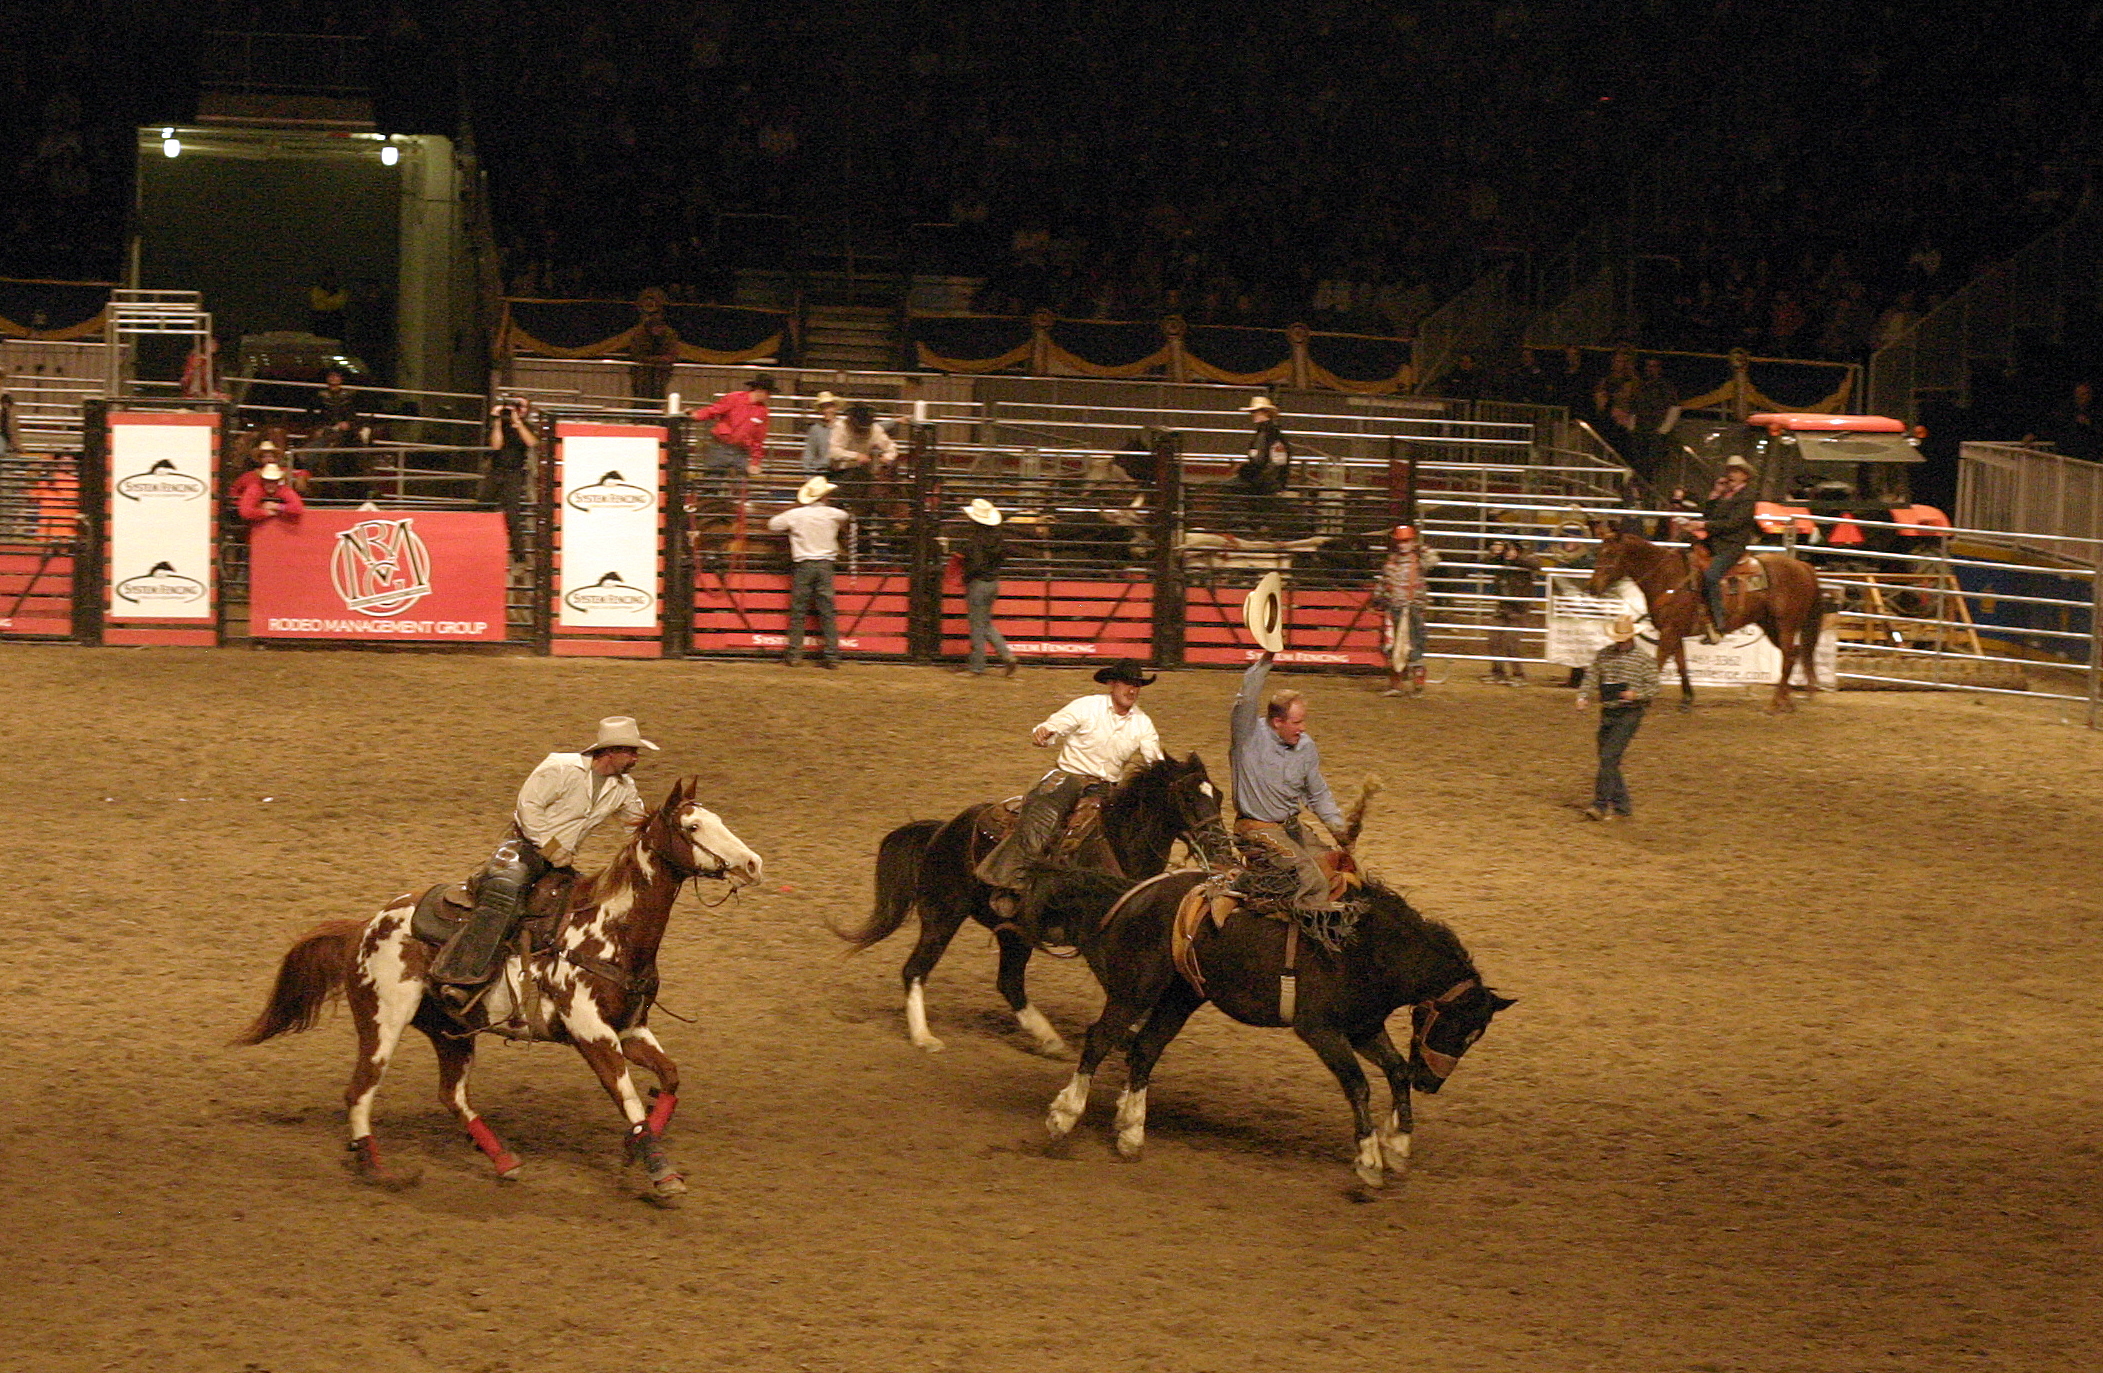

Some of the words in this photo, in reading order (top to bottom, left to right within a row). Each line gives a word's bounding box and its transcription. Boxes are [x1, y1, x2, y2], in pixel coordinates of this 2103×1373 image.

[268, 618, 322, 632] RODEO
[324, 619, 435, 634] MANAGEMENT
[435, 620, 488, 635] GROUP
[1041, 643, 1096, 653] FENCING
[1295, 652, 1350, 663] FENCING
